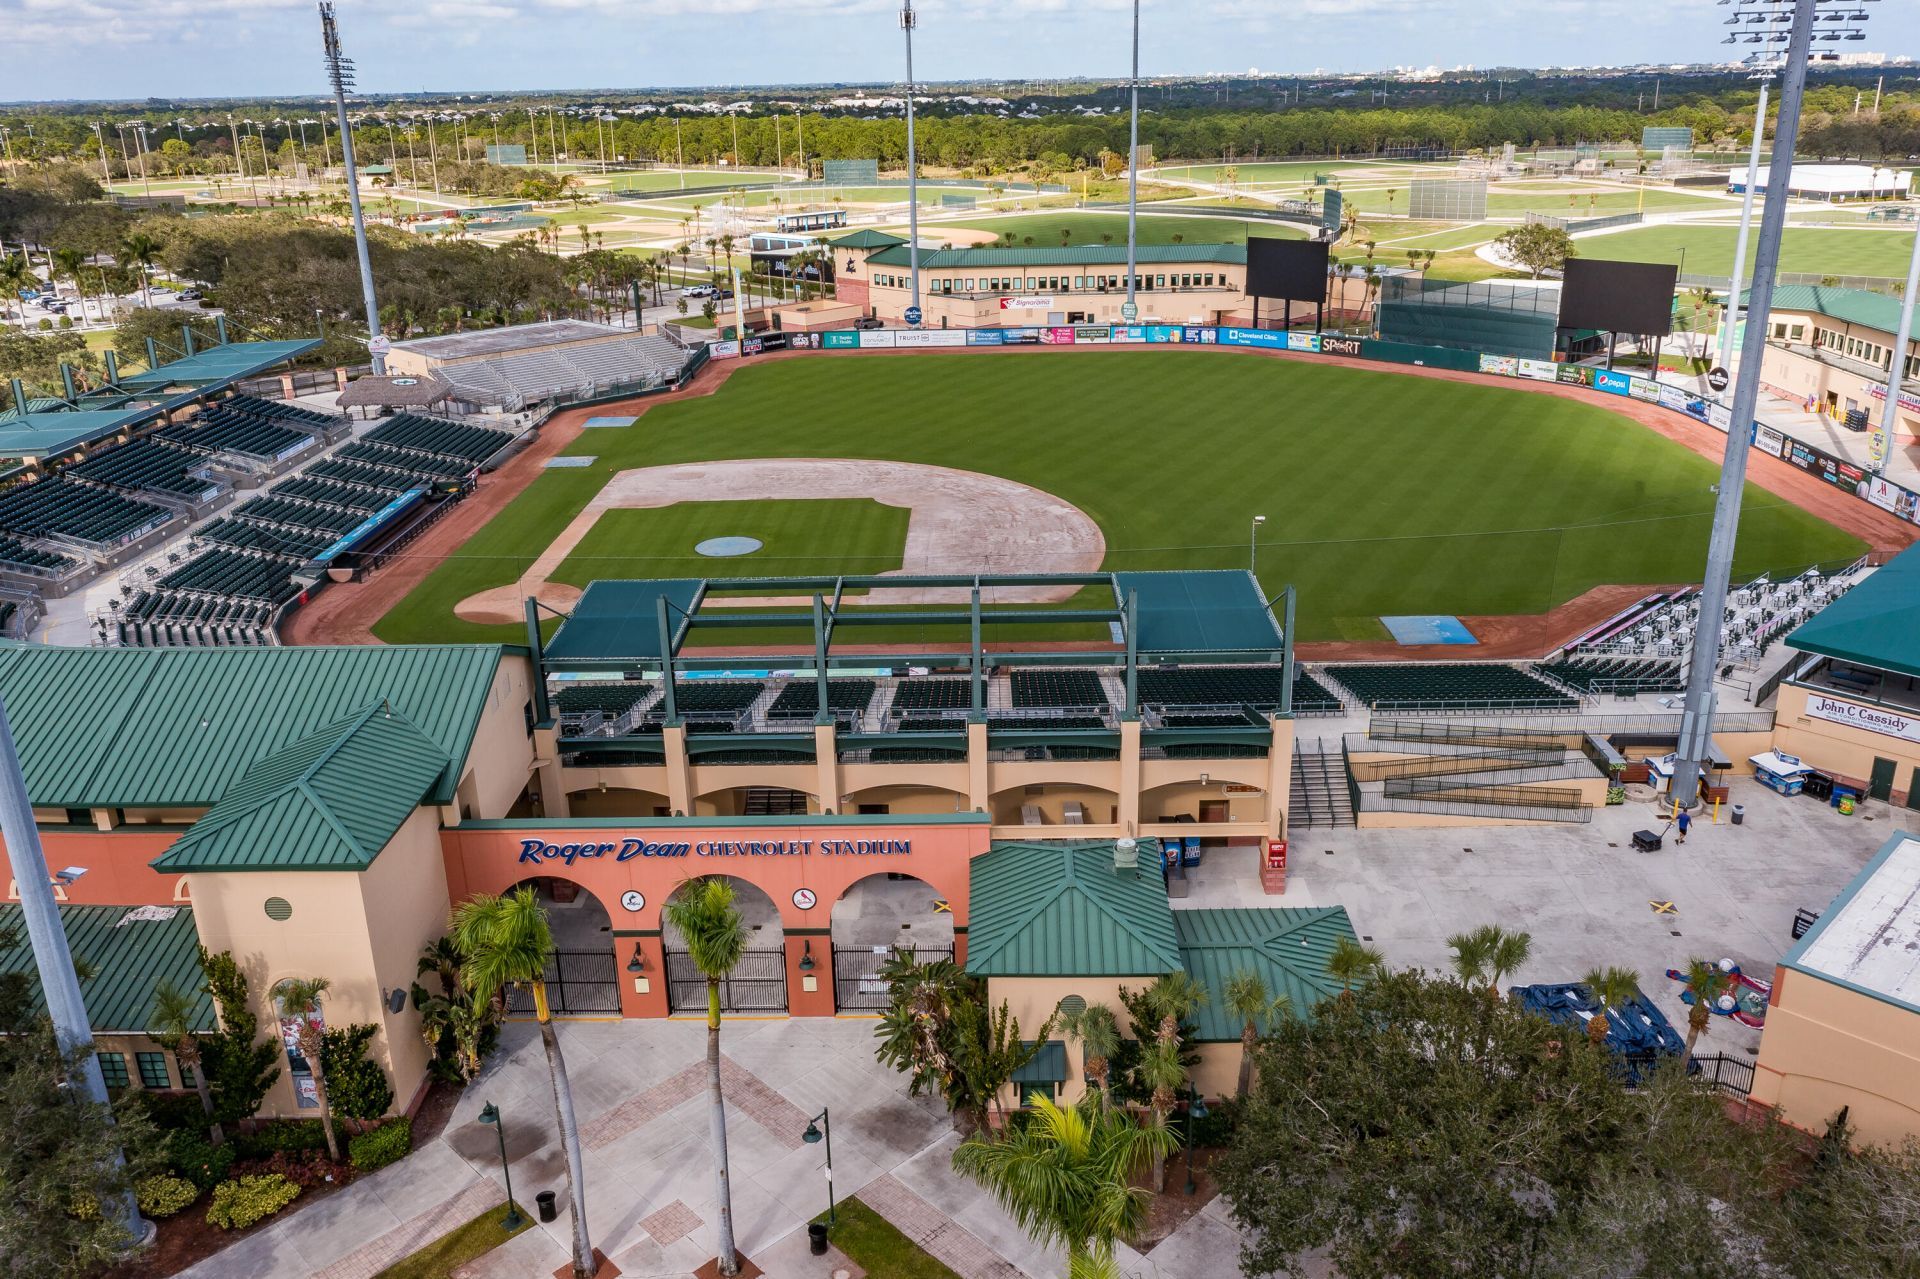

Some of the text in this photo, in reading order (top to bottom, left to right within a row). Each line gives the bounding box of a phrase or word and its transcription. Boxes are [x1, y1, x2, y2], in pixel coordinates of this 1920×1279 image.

[1238, 332, 1263, 340] Cleveland
[1607, 379, 1626, 388] pepsi
[1816, 699, 1909, 732] John C Cassidy
[1839, 713, 1882, 727] CONDITIONING
[518, 838, 911, 866] Roger Dean CHEVROLET STADIUM
